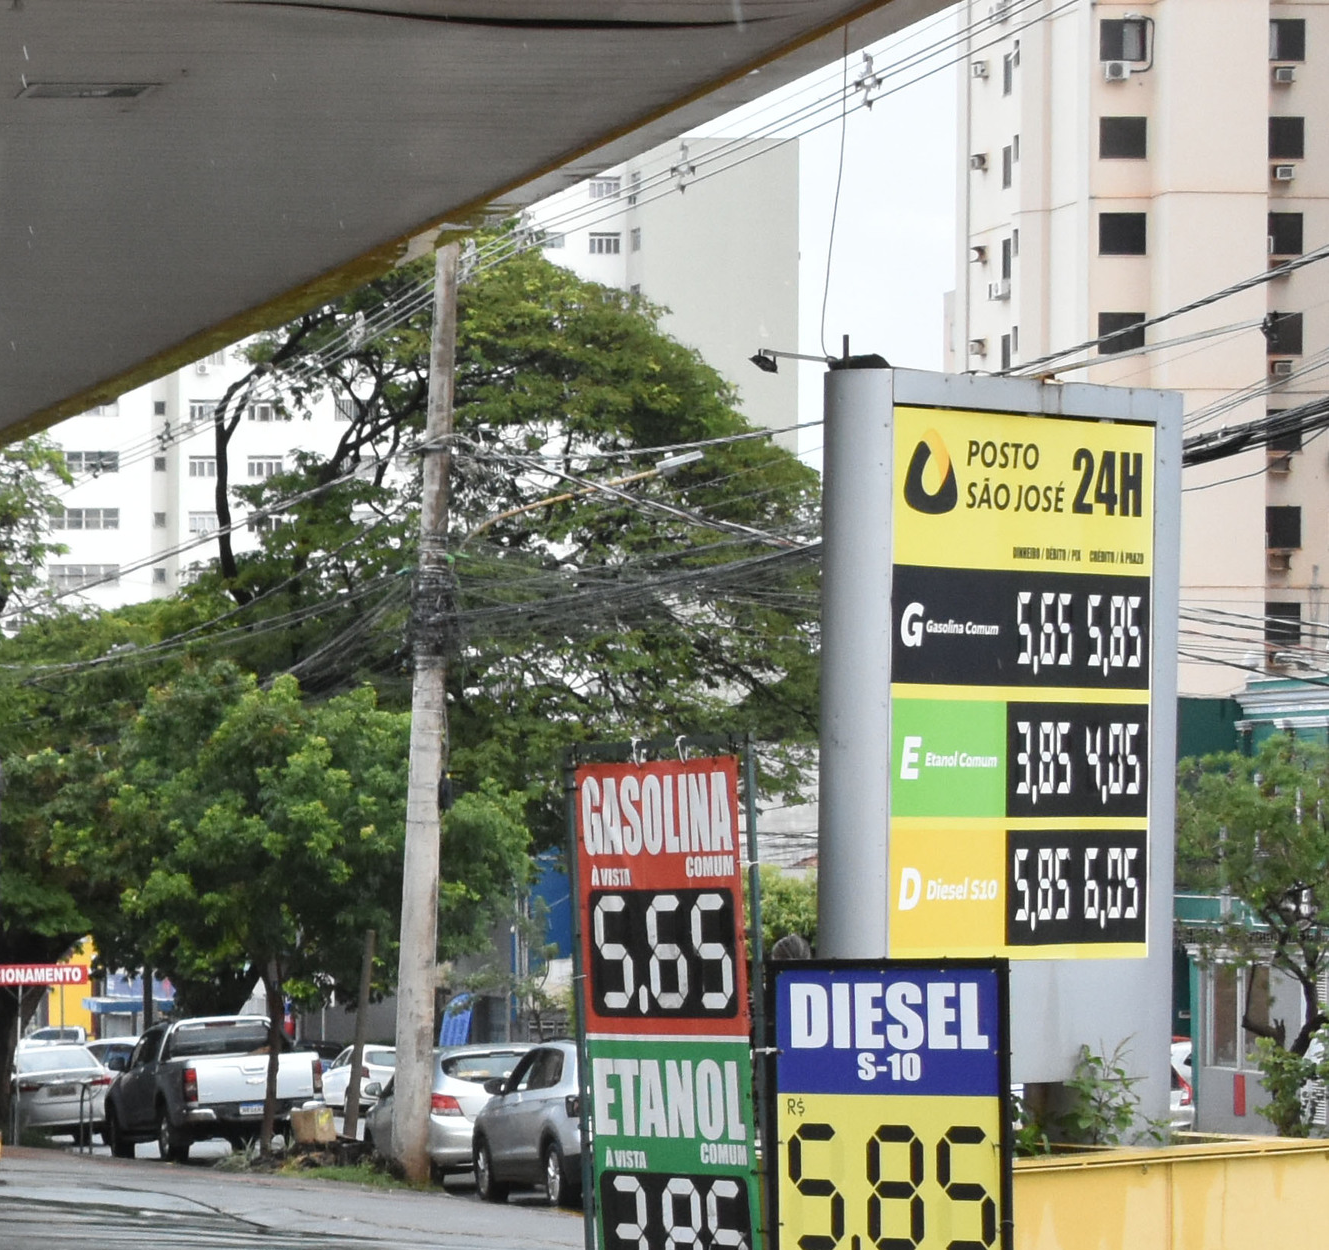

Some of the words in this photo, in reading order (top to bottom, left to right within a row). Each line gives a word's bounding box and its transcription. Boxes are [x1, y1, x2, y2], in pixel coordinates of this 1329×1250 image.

[966, 478, 1011, 510] SÃO
[1014, 481, 1065, 512] JOSÉ
[967, 440, 1040, 470] POSTO
[1072, 447, 1143, 517] 24H
[901, 602, 924, 647] G
[926, 619, 964, 633] Gasolina
[966, 621, 999, 636] Comum
[1017, 592, 1072, 675] 5,65
[1087, 594, 1141, 677] 5,85
[900, 736, 922, 779] E
[925, 751, 959, 767] Etanol
[959, 753, 998, 768] Comum
[1016, 722, 1071, 804] 3,85
[1086, 723, 1140, 804] 4,05
[582, 771, 734, 856] GASOLINA
[601, 868, 631, 887] VISTA
[685, 855, 735, 878] COMUM
[898, 867, 922, 910] D
[927, 878, 968, 900] Diesel
[970, 879, 998, 900] S10
[1015, 849, 1070, 931] 5,85
[1084, 848, 1139, 929] 6,05
[790, 981, 989, 1051] DIESEL
[857, 1052, 922, 1082] S-10
[592, 1057, 746, 1141] ETANOL
[788, 1098, 805, 1117] R$
[615, 1149, 647, 1169] VISTA
[700, 1143, 748, 1166] COMUM
